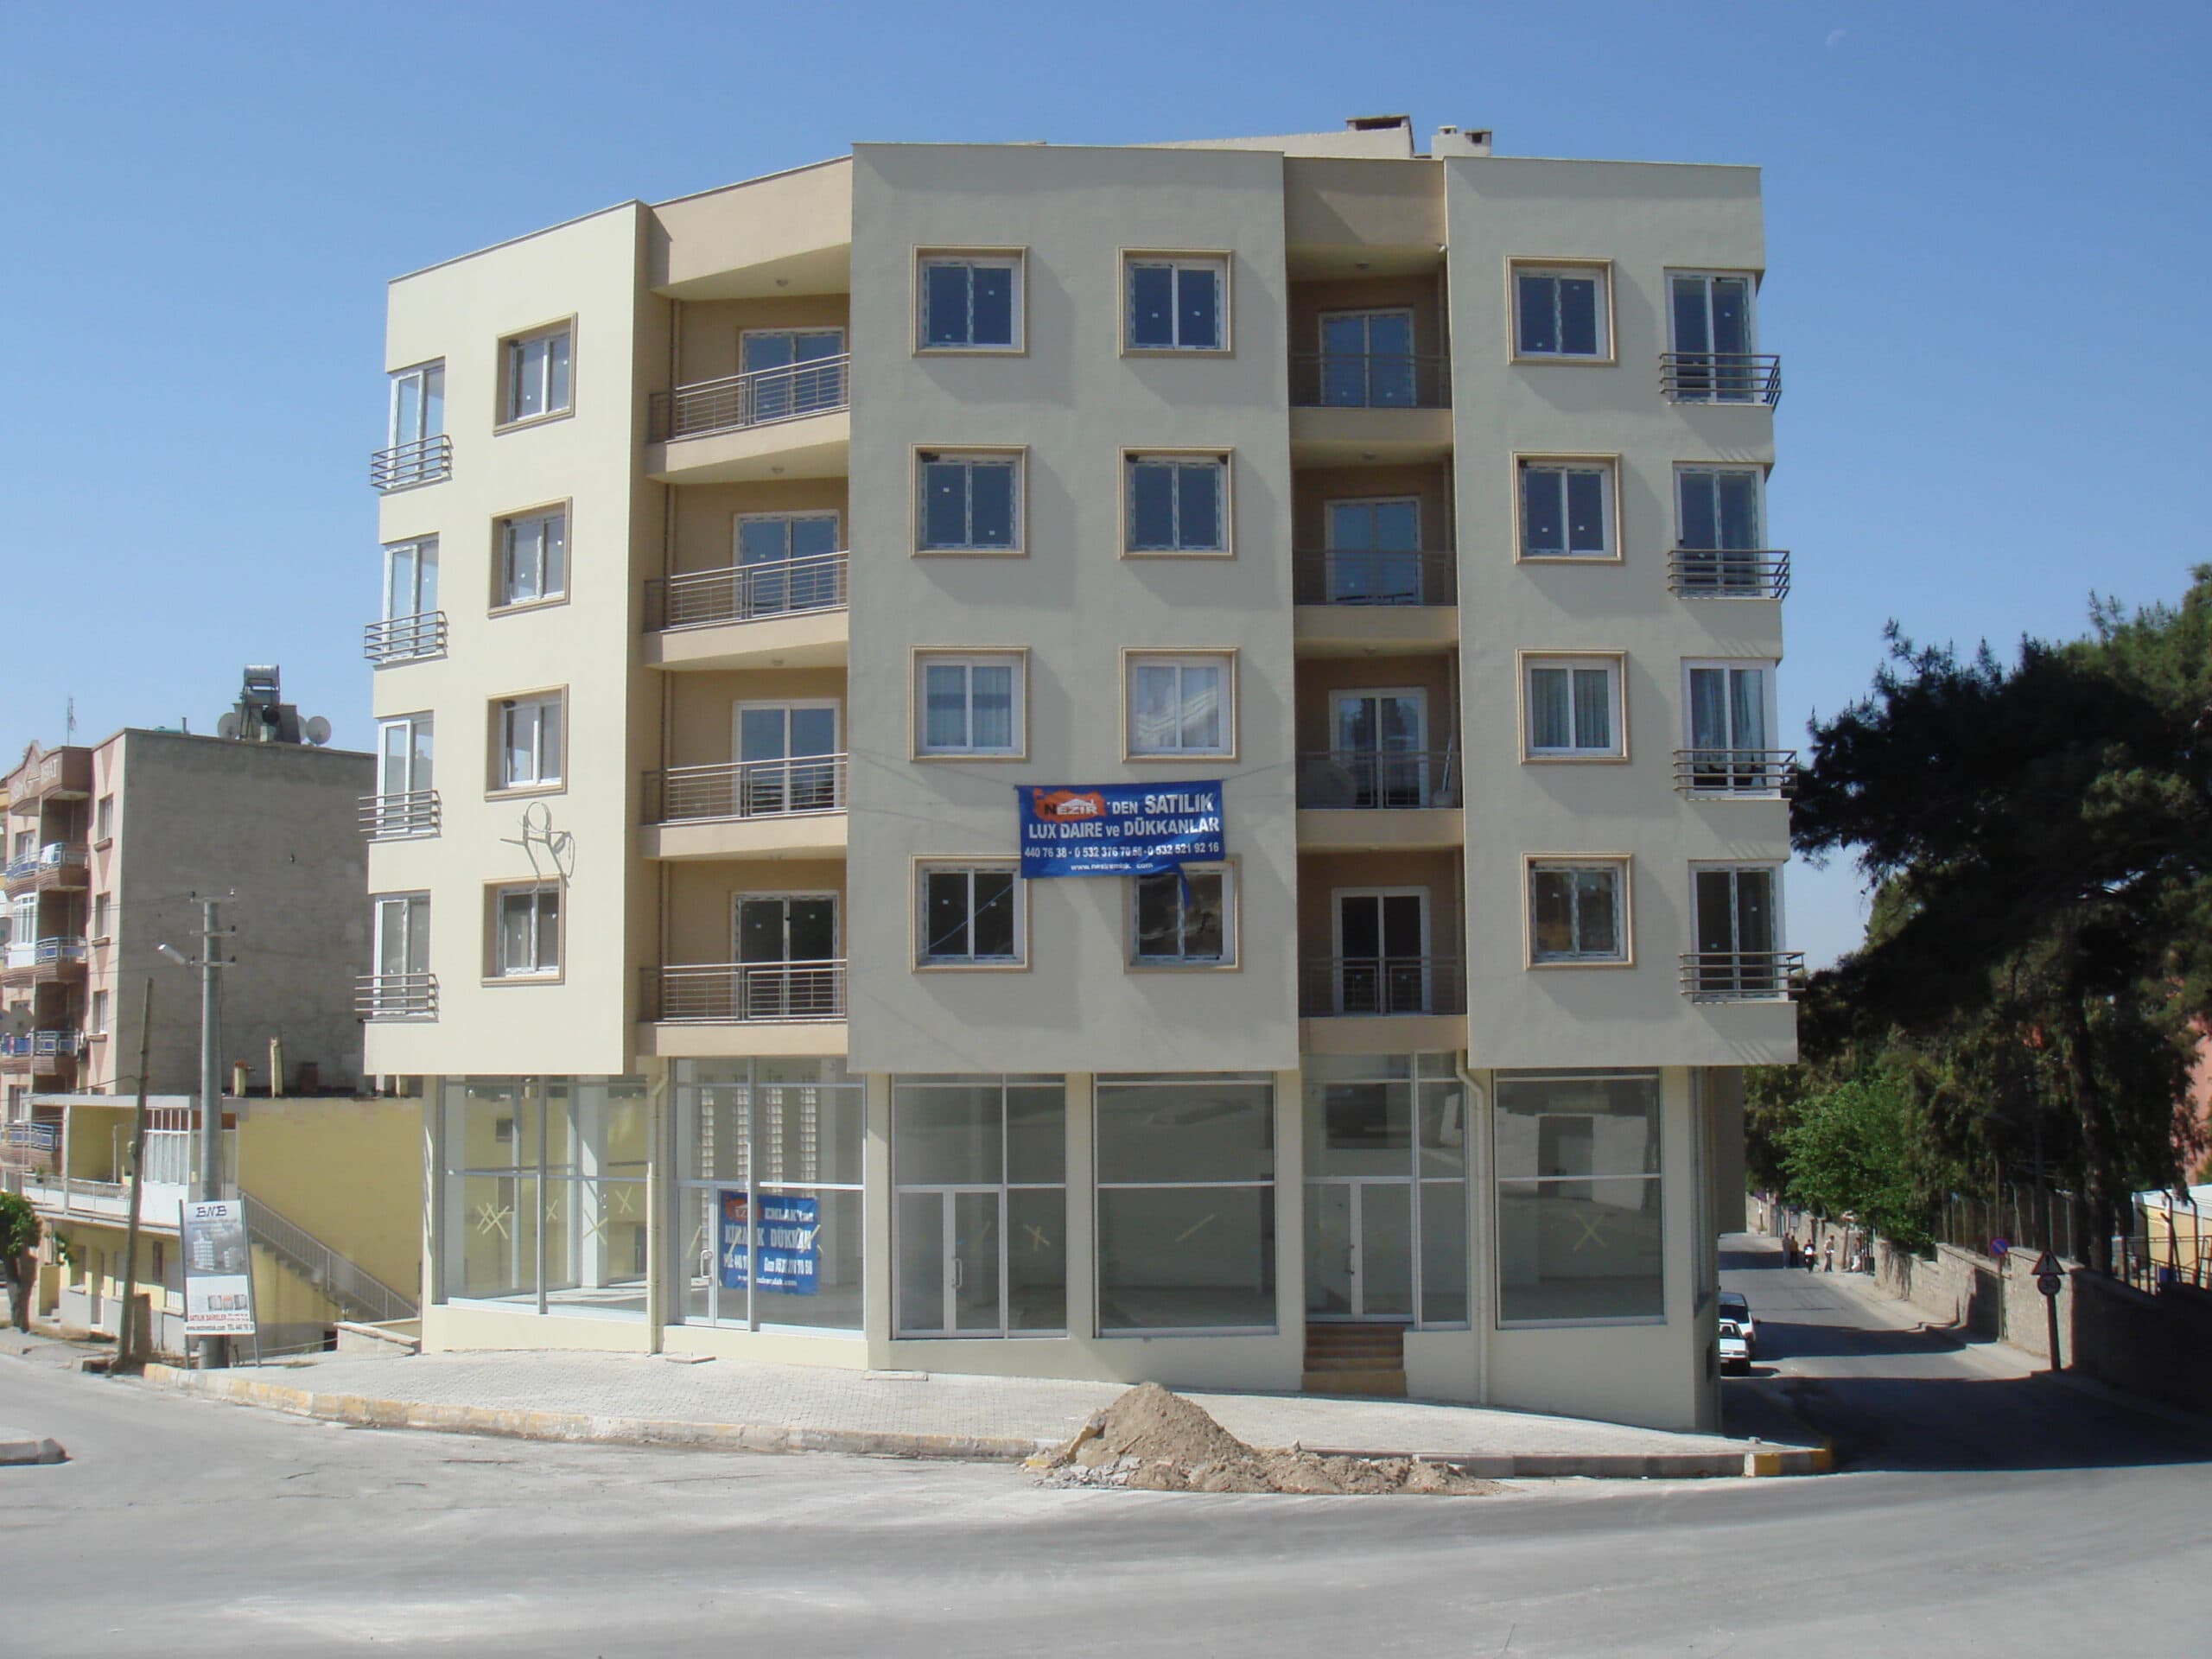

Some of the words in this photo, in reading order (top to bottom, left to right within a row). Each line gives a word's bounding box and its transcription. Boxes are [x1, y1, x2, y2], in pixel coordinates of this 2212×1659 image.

[1144, 792, 1214, 815] SATILIK
[1029, 823, 1057, 840] LUX
[1060, 821, 1103, 838] DAIRE
[1105, 825, 1120, 837] ve
[1124, 817, 1220, 836] DÜKKANLAR
[1025, 847, 1040, 858] 440
[1043, 847, 1054, 858] 76
[1056, 846, 1068, 858] 38
[1083, 846, 1100, 858] 532
[1101, 846, 1118, 857] 376
[1155, 844, 1173, 855] 532
[1175, 843, 1191, 855] 521
[1194, 842, 1206, 854] 92
[1208, 842, 1219, 853] 16
[195, 1205, 227, 1217] BNB
